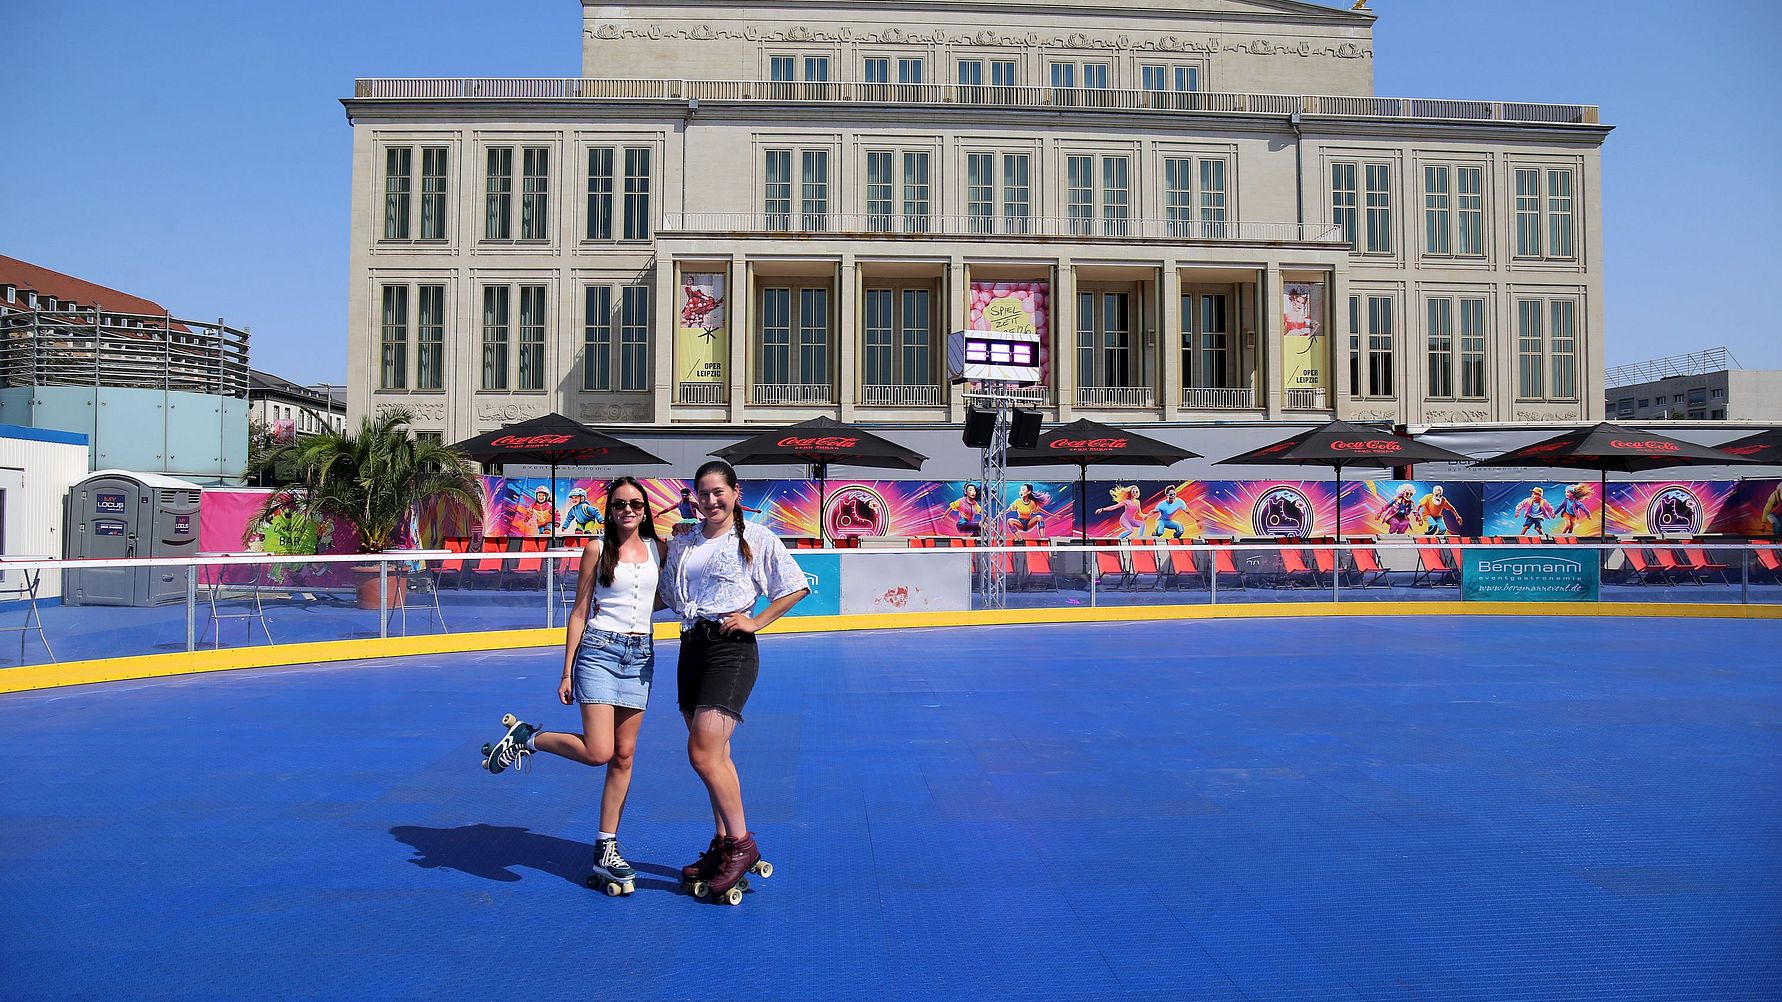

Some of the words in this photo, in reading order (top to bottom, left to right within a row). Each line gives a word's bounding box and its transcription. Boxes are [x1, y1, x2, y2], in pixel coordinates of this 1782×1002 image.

[991, 306, 1021, 316] SPIEL
[280, 536, 301, 546] BAR
[1478, 583, 1582, 594] www.bergmannevent.de
